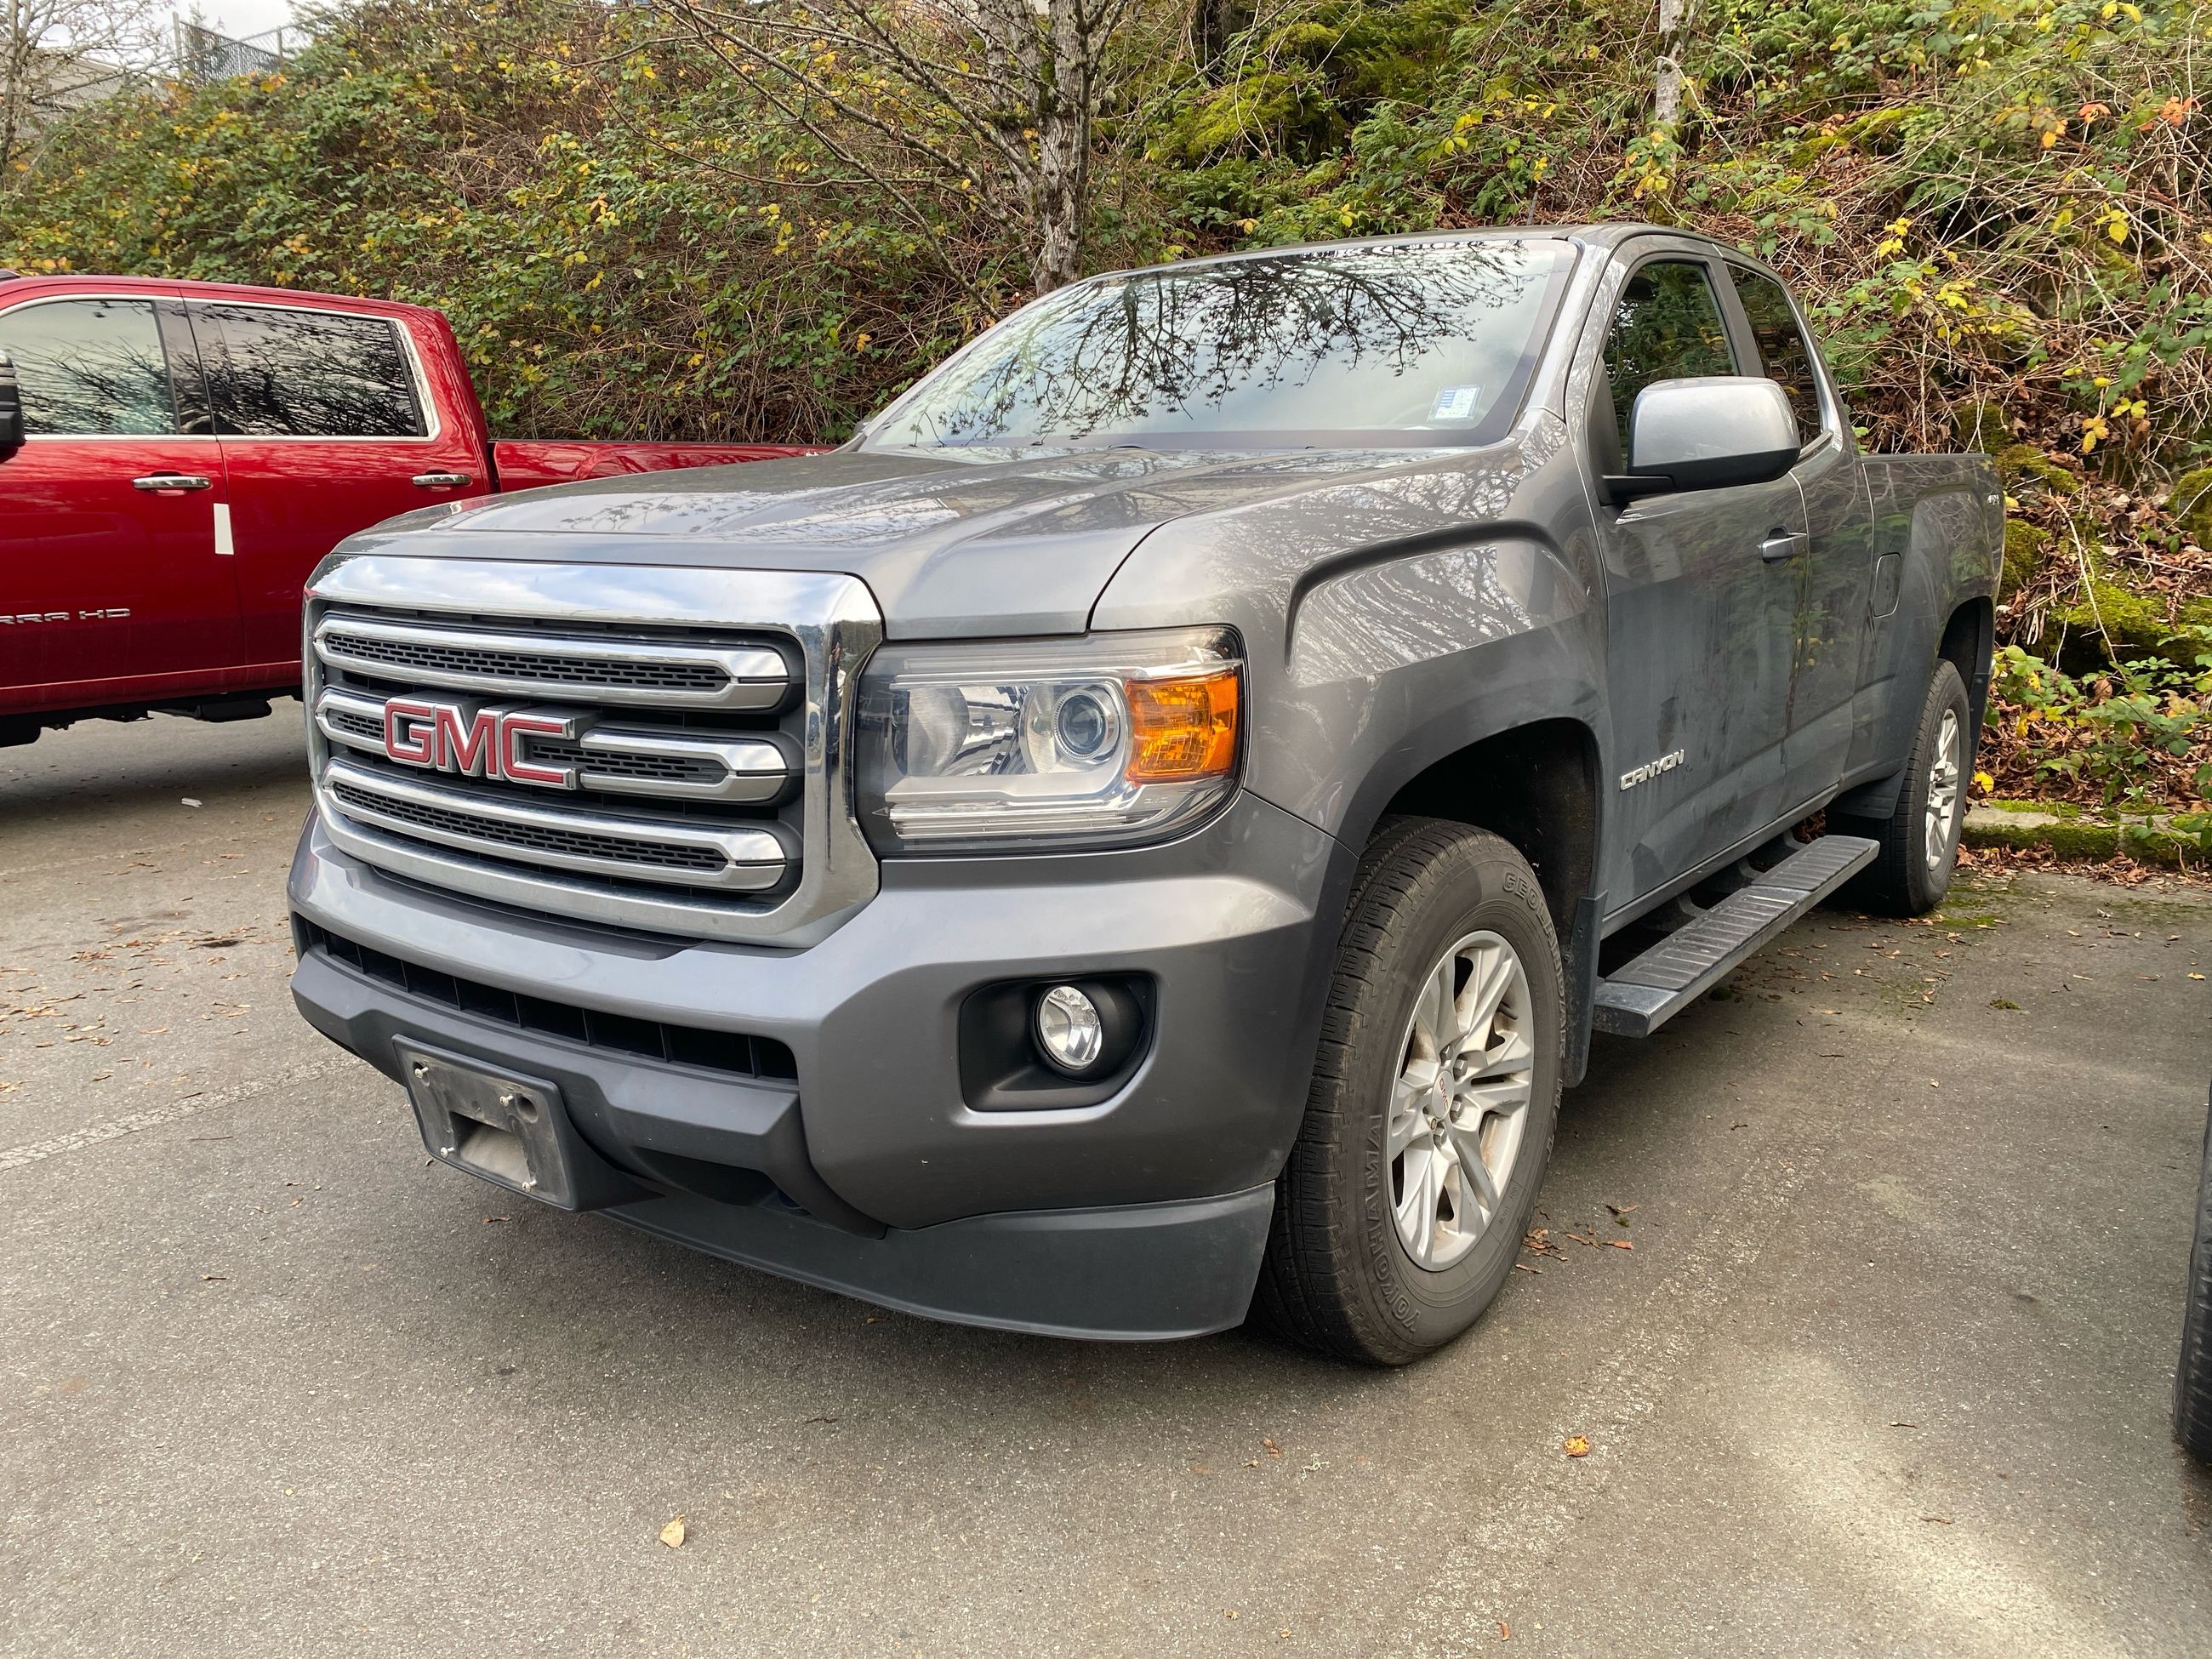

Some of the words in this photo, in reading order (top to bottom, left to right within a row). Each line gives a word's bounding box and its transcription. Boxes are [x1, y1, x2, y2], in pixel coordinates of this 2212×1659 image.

[79, 607, 130, 620] HD
[384, 697, 577, 790] GMC
[1620, 749, 1685, 791] CANYON
[1502, 871, 1566, 1059] GEOLANDAR
[1365, 1114, 1421, 1333] YOKOHAMA
